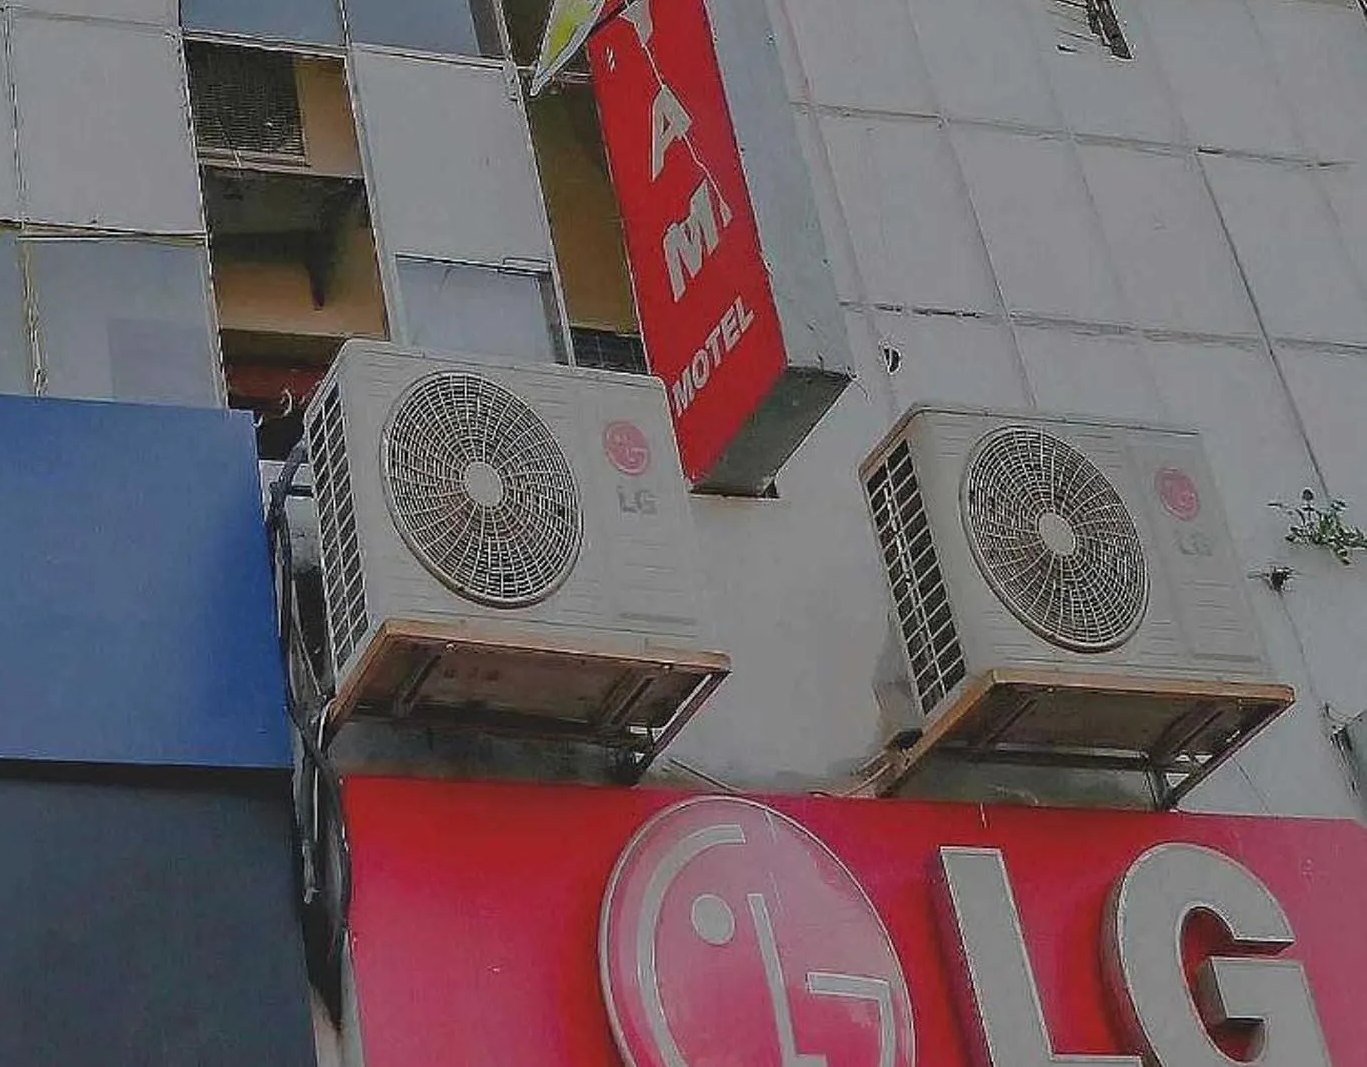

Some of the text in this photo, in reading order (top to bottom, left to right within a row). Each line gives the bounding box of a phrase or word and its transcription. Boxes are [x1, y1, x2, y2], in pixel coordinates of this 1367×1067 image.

[671, 294, 755, 418] MOTEL
[616, 485, 657, 514] LG
[937, 841, 1335, 1067] LG
